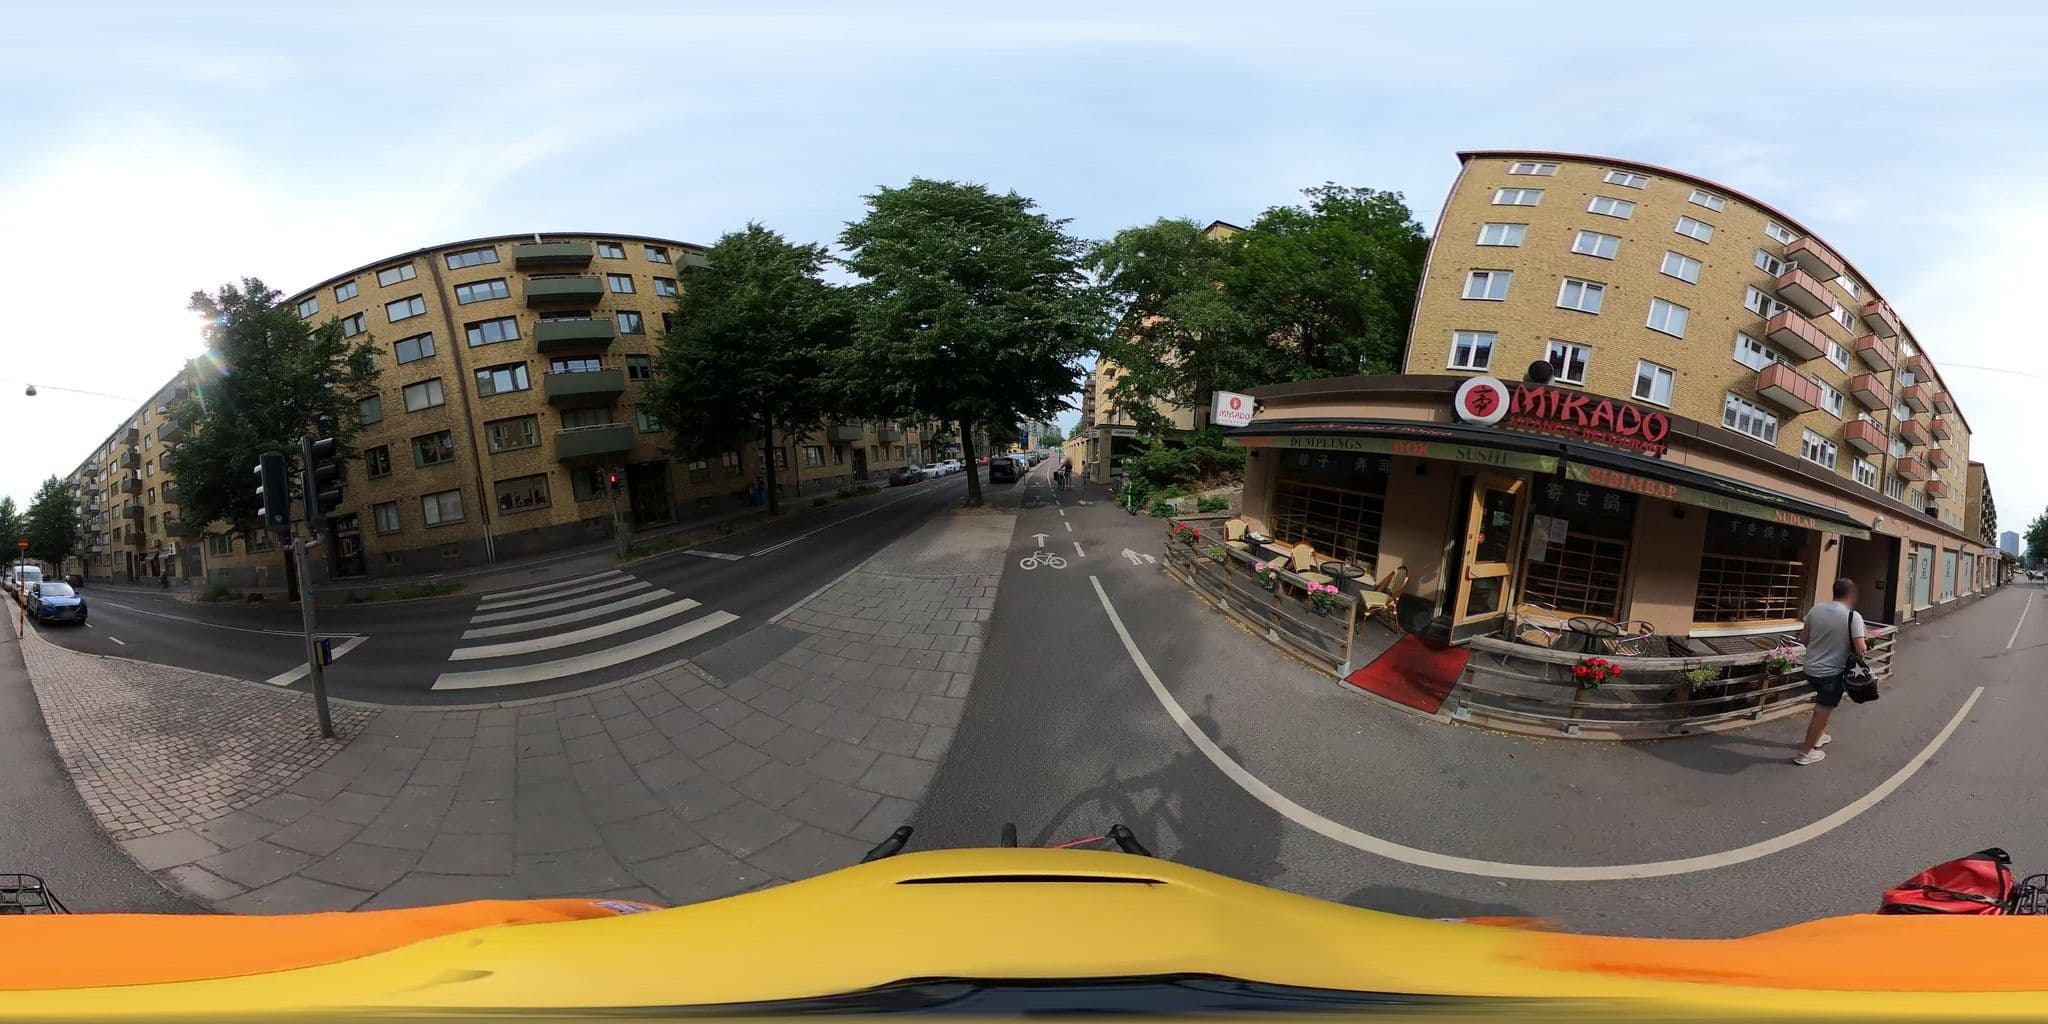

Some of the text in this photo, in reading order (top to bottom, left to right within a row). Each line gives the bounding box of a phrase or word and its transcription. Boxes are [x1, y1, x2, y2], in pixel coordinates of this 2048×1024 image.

[1509, 383, 1669, 441] MIKADO
[1290, 437, 1362, 449] DUMPLINGS
[1392, 441, 1428, 456] WOK
[1456, 448, 1507, 465] SUSHI
[1775, 511, 1816, 529] NUDLAR
